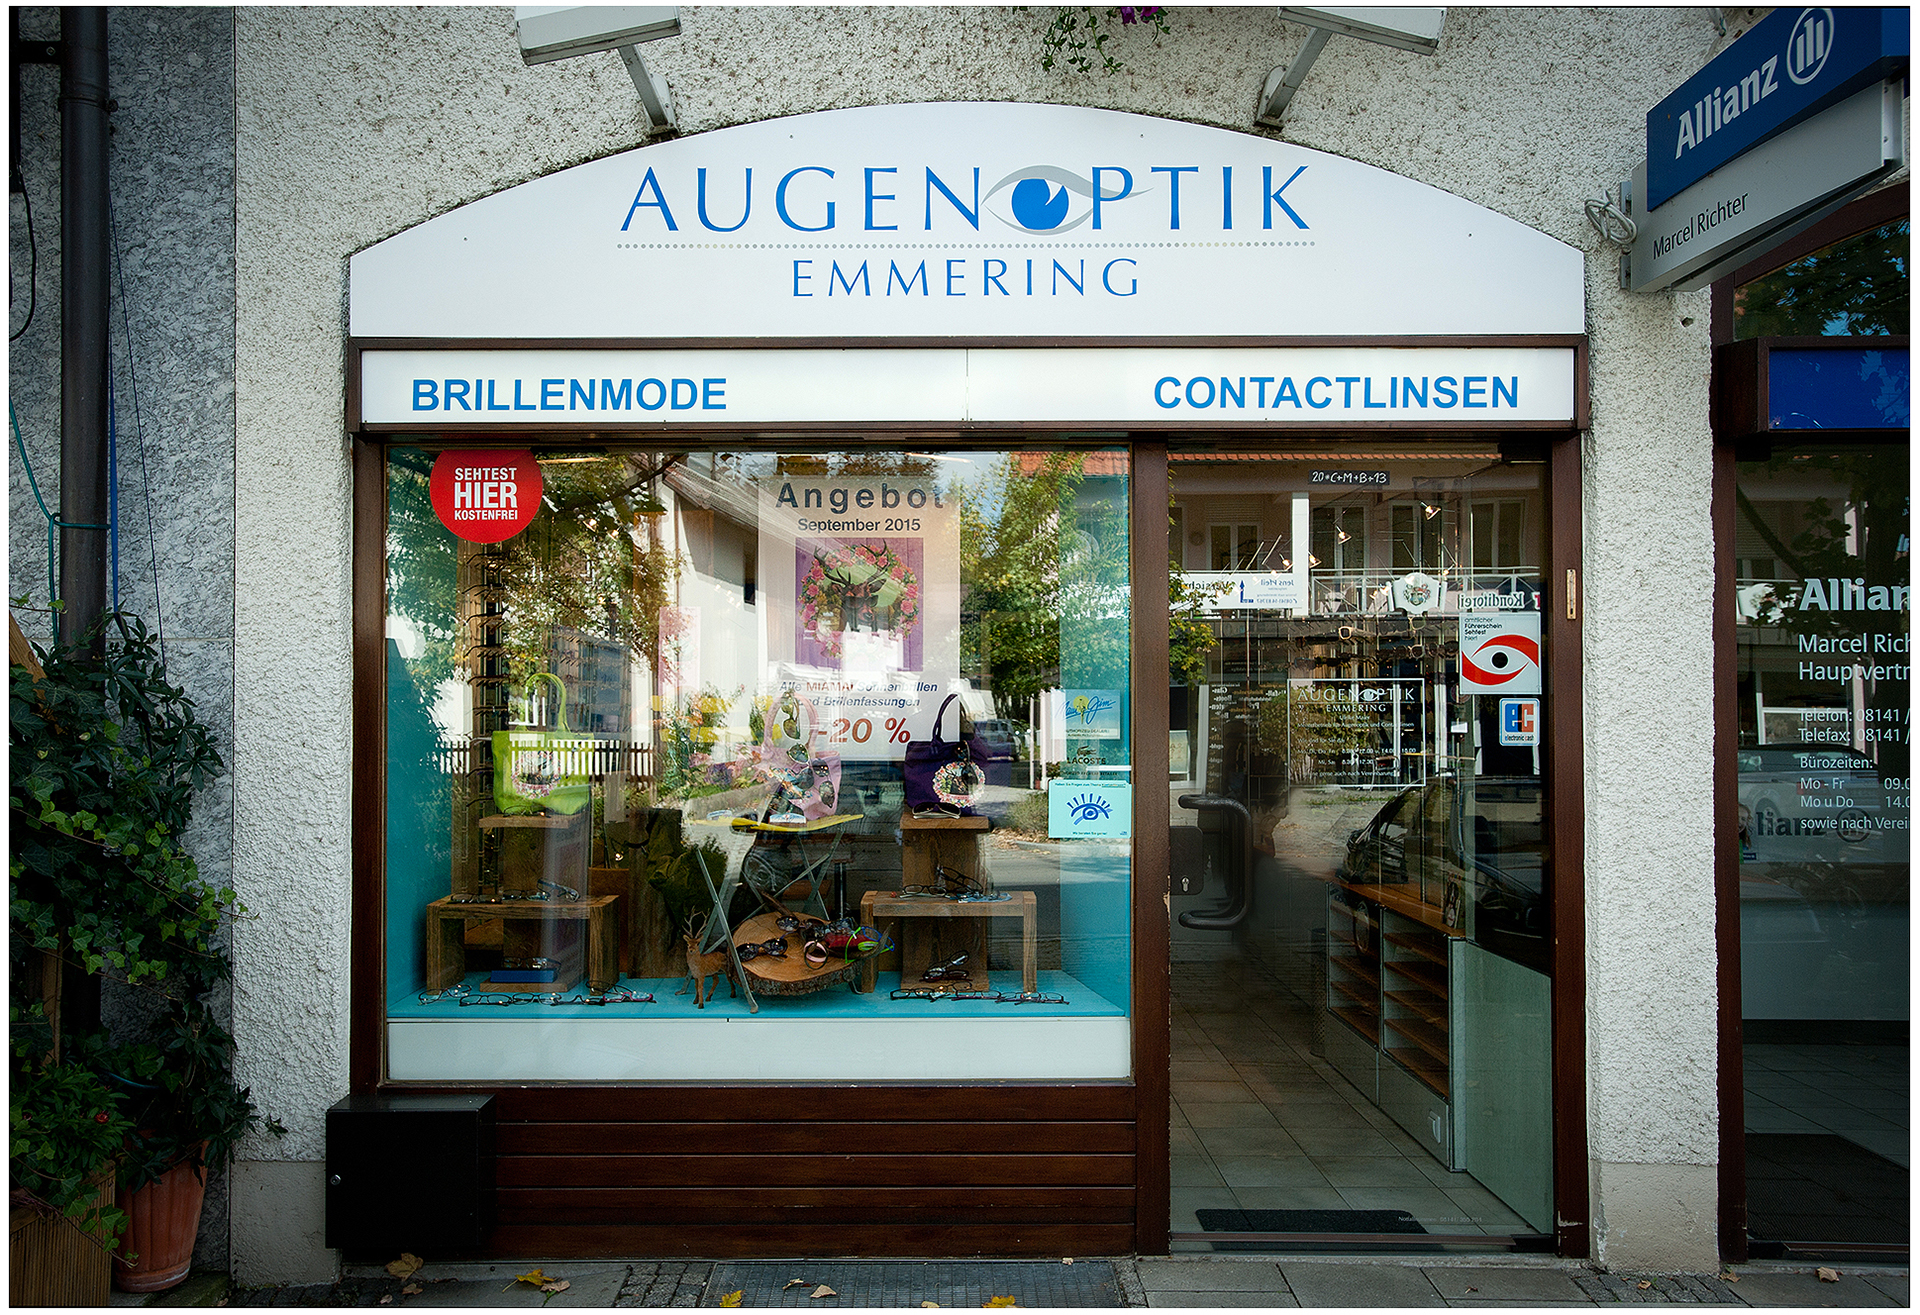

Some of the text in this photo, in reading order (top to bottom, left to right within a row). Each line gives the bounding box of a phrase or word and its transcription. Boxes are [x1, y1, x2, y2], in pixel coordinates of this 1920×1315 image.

[1674, 54, 1779, 161] Allianz
[1652, 192, 1749, 260] Marcel Richter
[792, 258, 1139, 297] EMMERING
[411, 377, 728, 412] BRILLENMODE
[1153, 375, 1519, 410] CONTACTLINSEN
[454, 467, 518, 481] SEHTEST
[454, 481, 518, 509] HIER
[775, 482, 944, 515] Angebot
[454, 509, 518, 521] KOSTENFREI
[797, 518, 921, 534] September 2015
[1798, 632, 1867, 653] Marcel
[1326, 704, 1387, 712] EMMERING
[1798, 707, 1853, 722] Telefon:
[1856, 708, 1900, 722] 08141
[884, 717, 911, 744] %
[1798, 727, 1851, 742] Telefax:
[1856, 728, 1900, 742] 08141
[1066, 756, 1107, 765] LACOSTE
[1800, 756, 1873, 769] Bürozeiten:
[1800, 777, 1821, 790] Mo
[1832, 777, 1845, 790] Fr
[1800, 795, 1821, 808] Mo
[1824, 798, 1833, 808] u
[1836, 795, 1855, 808] Do
[1800, 816, 1838, 829] sowie
[1841, 816, 1872, 829] nach
